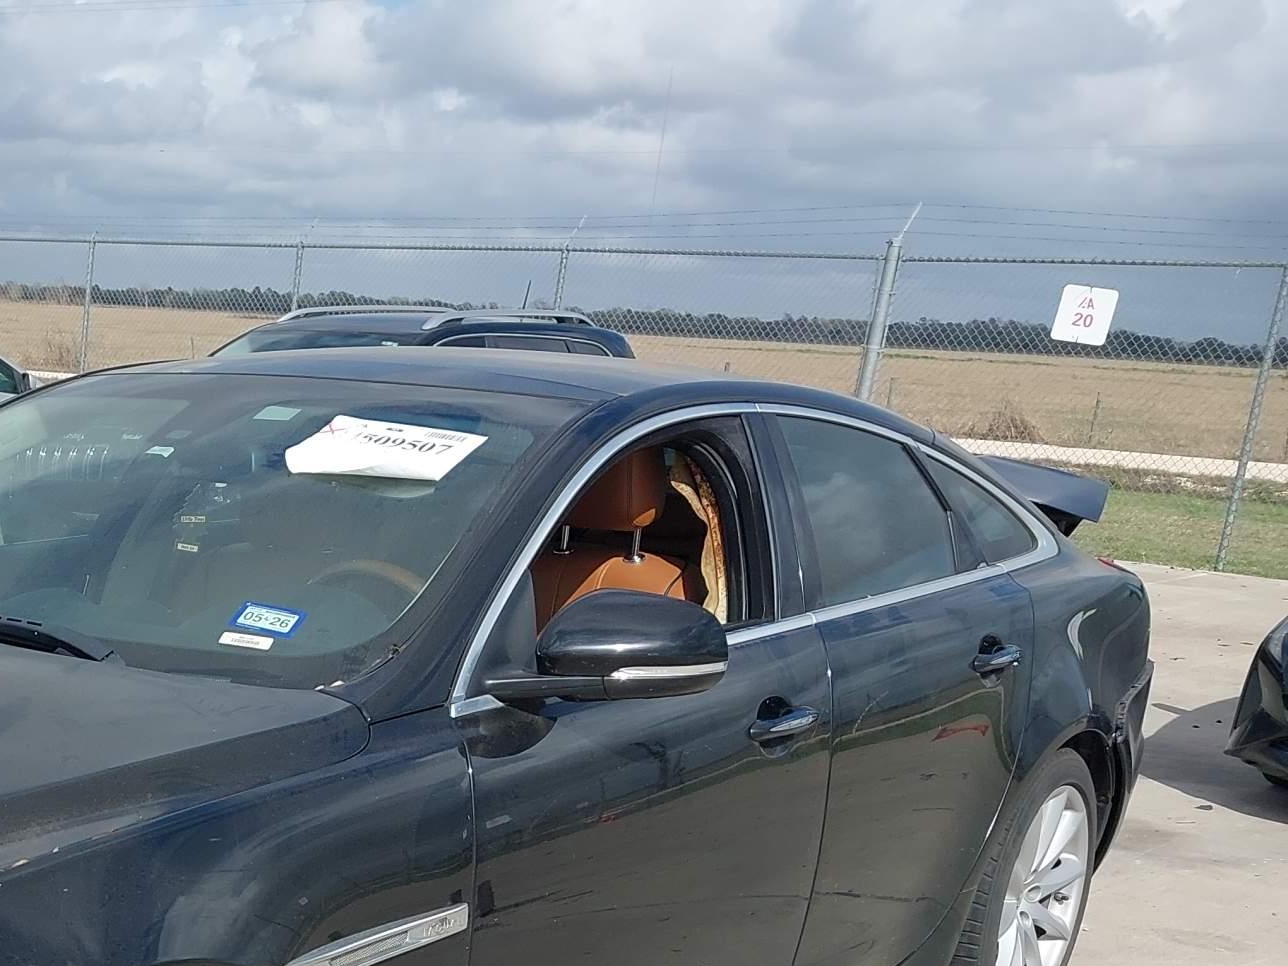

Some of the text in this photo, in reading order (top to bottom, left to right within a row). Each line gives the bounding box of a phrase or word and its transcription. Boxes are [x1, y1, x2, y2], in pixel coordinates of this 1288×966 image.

[1071, 312, 1094, 328] 20
[243, 611, 265, 623] 05
[268, 616, 291, 629] 26
